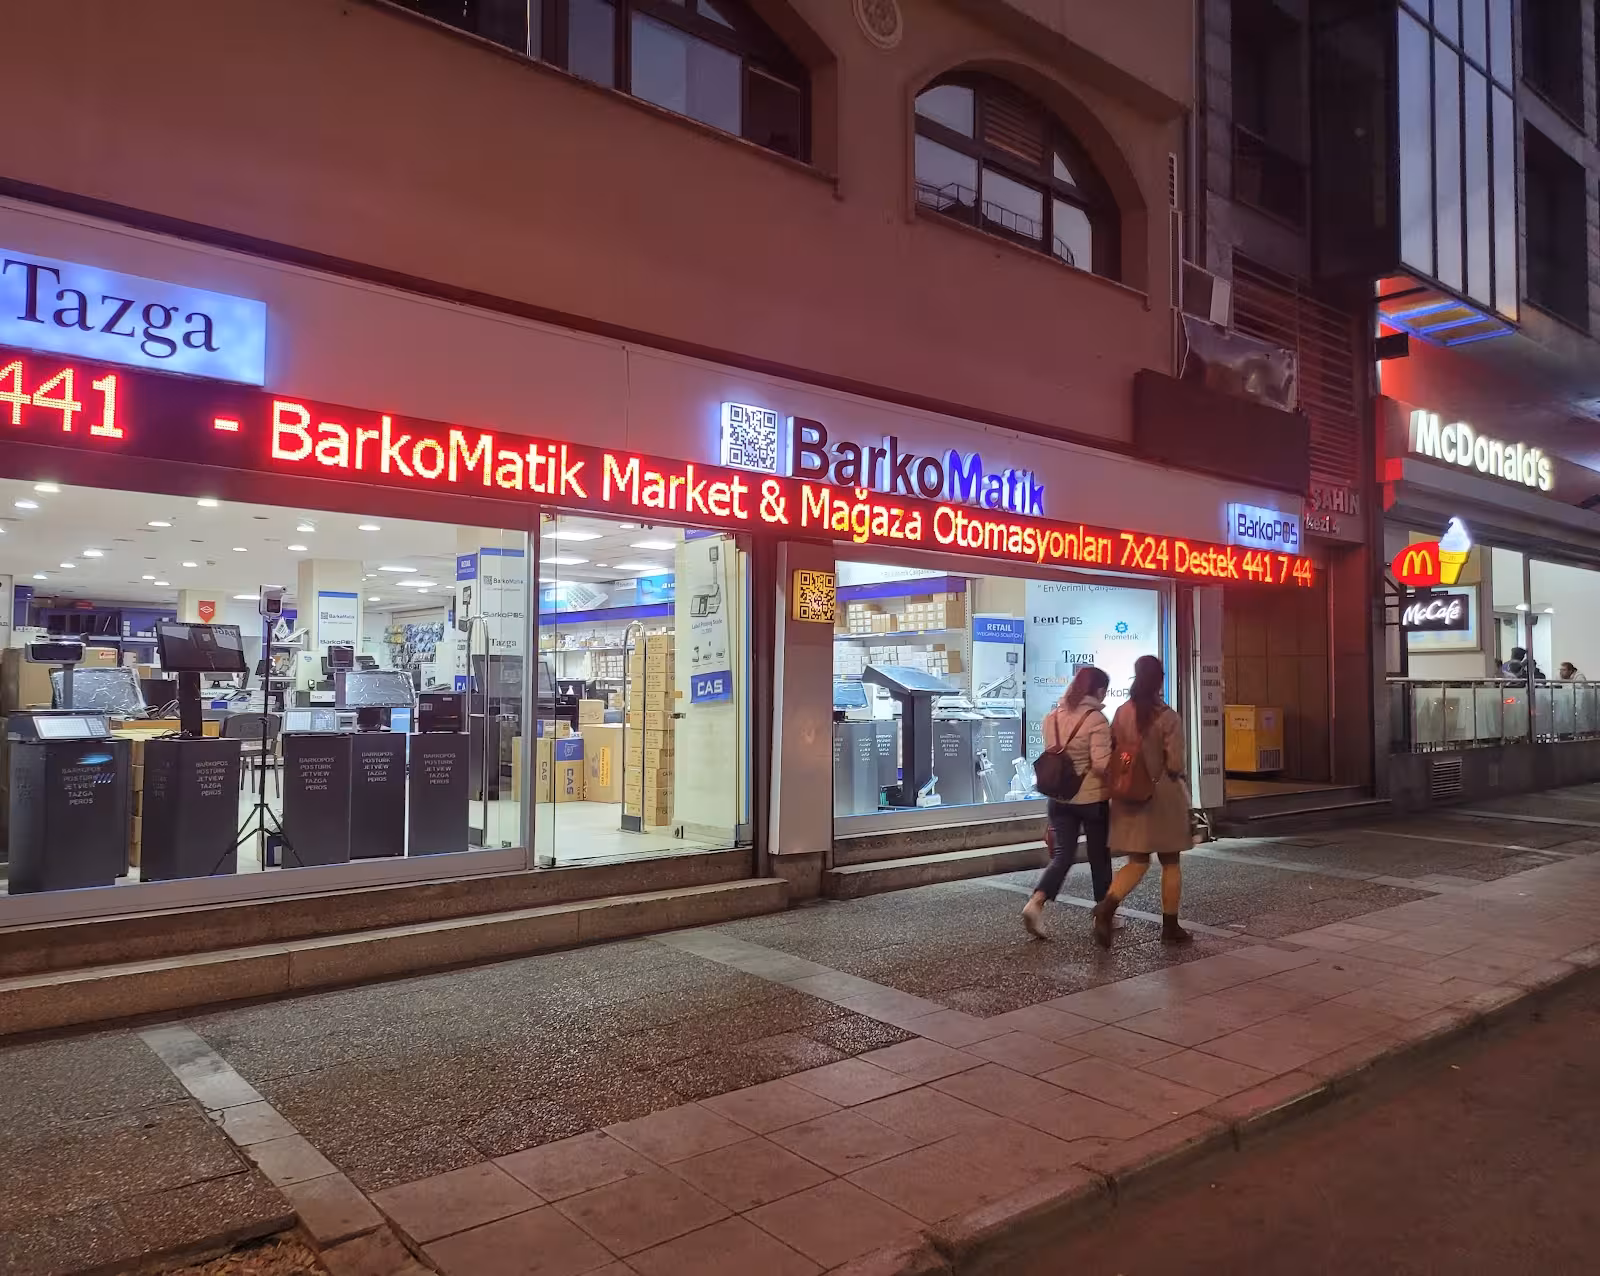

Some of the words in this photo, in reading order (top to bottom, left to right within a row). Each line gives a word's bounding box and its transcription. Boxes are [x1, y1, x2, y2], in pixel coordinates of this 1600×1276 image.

[3, 259, 220, 358] Tazga
[1409, 409, 1554, 492] McDonald's
[0, 360, 124, 440] 441
[271, 399, 588, 499] BarkoMatik
[603, 453, 748, 520] Market
[759, 479, 789, 525] &
[801, 484, 922, 544] Mağaza
[933, 506, 1112, 565] Otomasyonları
[1119, 532, 1168, 571] 7x24
[1174, 540, 1239, 580] Destek
[1242, 551, 1273, 583] 441
[1278, 555, 1289, 584] 7
[1292, 558, 1312, 588] 44
[786, 415, 1046, 516] BarkoMatik
[1237, 513, 1298, 545] BarkoPOS
[1402, 599, 1462, 626] McCafé
[987, 623, 1012, 632] RETAIL
[1104, 633, 1140, 641] Prometrik
[1062, 650, 1094, 664] Tazga
[697, 679, 724, 697] CAS
[566, 768, 574, 795] CAS
